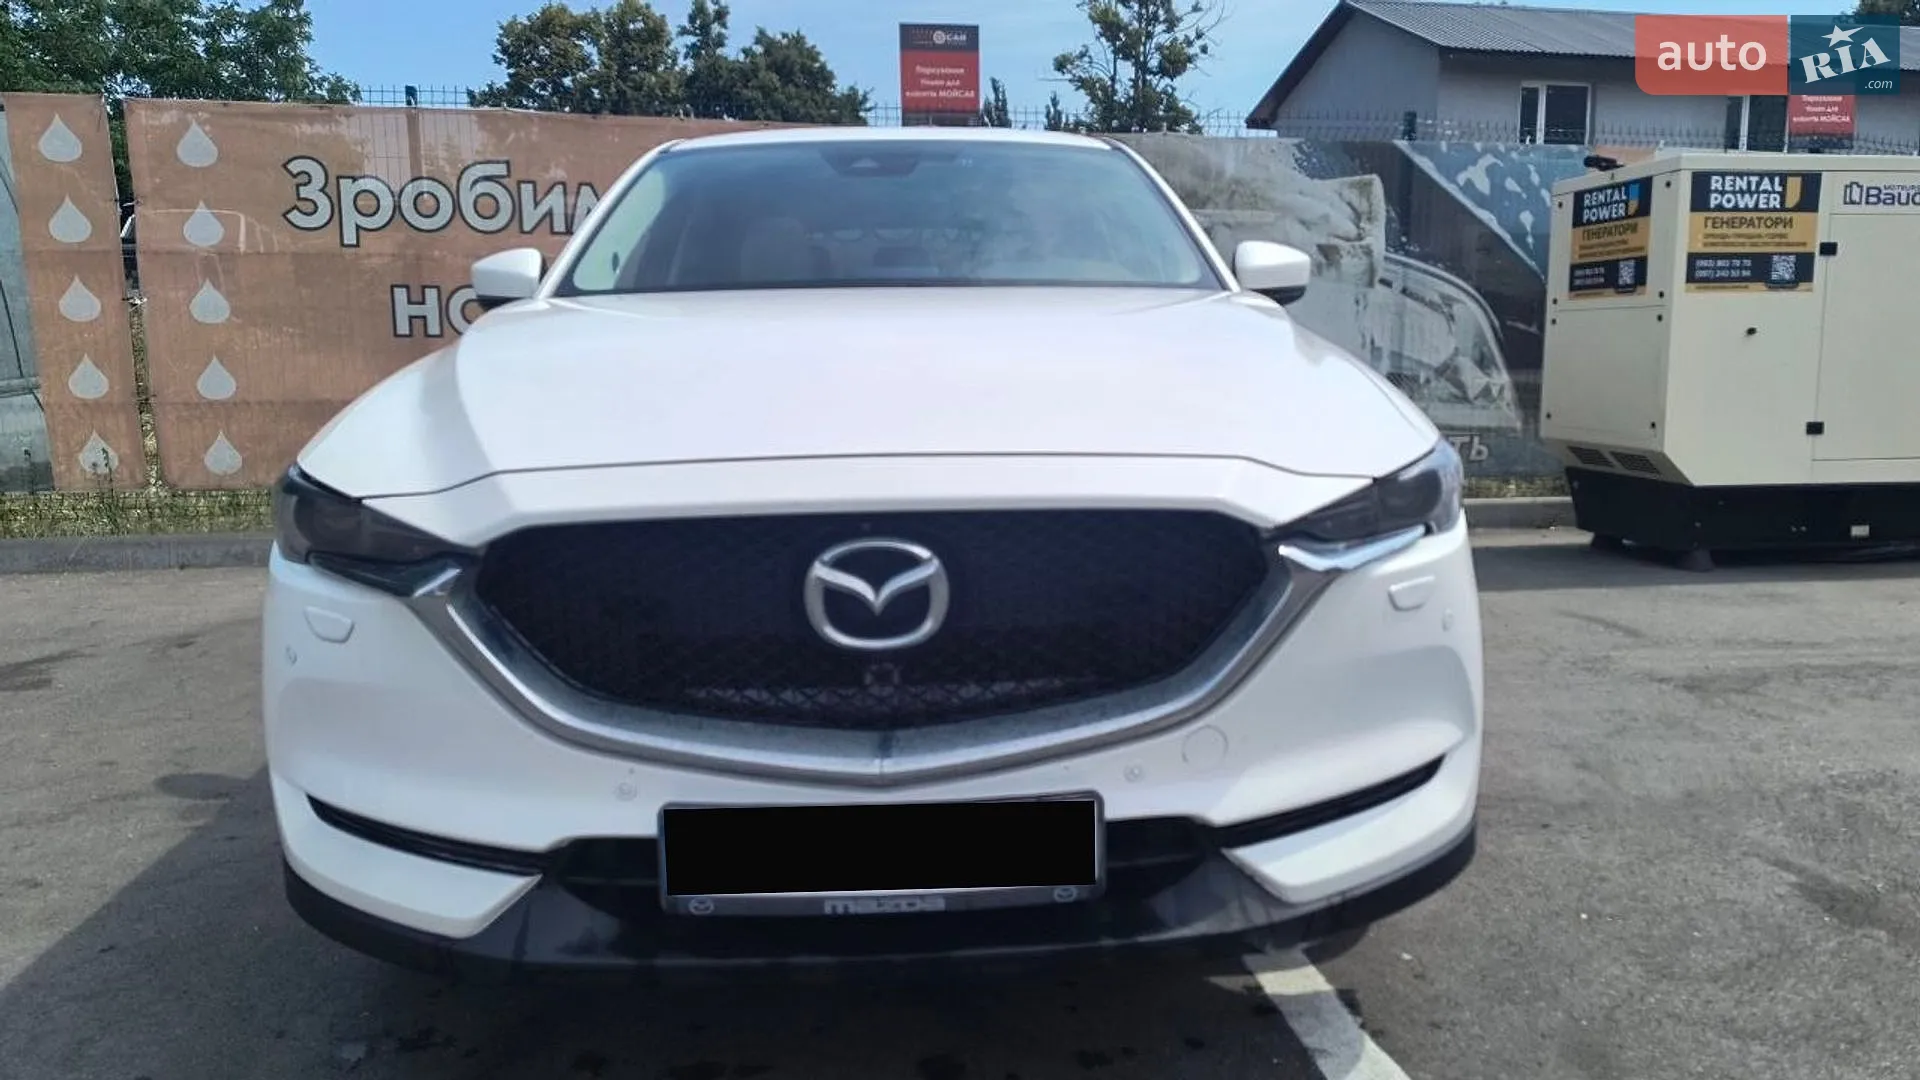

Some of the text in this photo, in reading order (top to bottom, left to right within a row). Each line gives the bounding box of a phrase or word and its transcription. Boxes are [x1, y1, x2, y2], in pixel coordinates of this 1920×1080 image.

[1710, 175, 1783, 192] RENTAL
[1583, 185, 1627, 208] RENTAL
[1709, 193, 1781, 209] POWER
[1582, 202, 1626, 223] POWER
[1704, 215, 1794, 229] ГЕНЕРАТОРИ
[1581, 222, 1638, 241] ГЕНЕРАТОРИ
